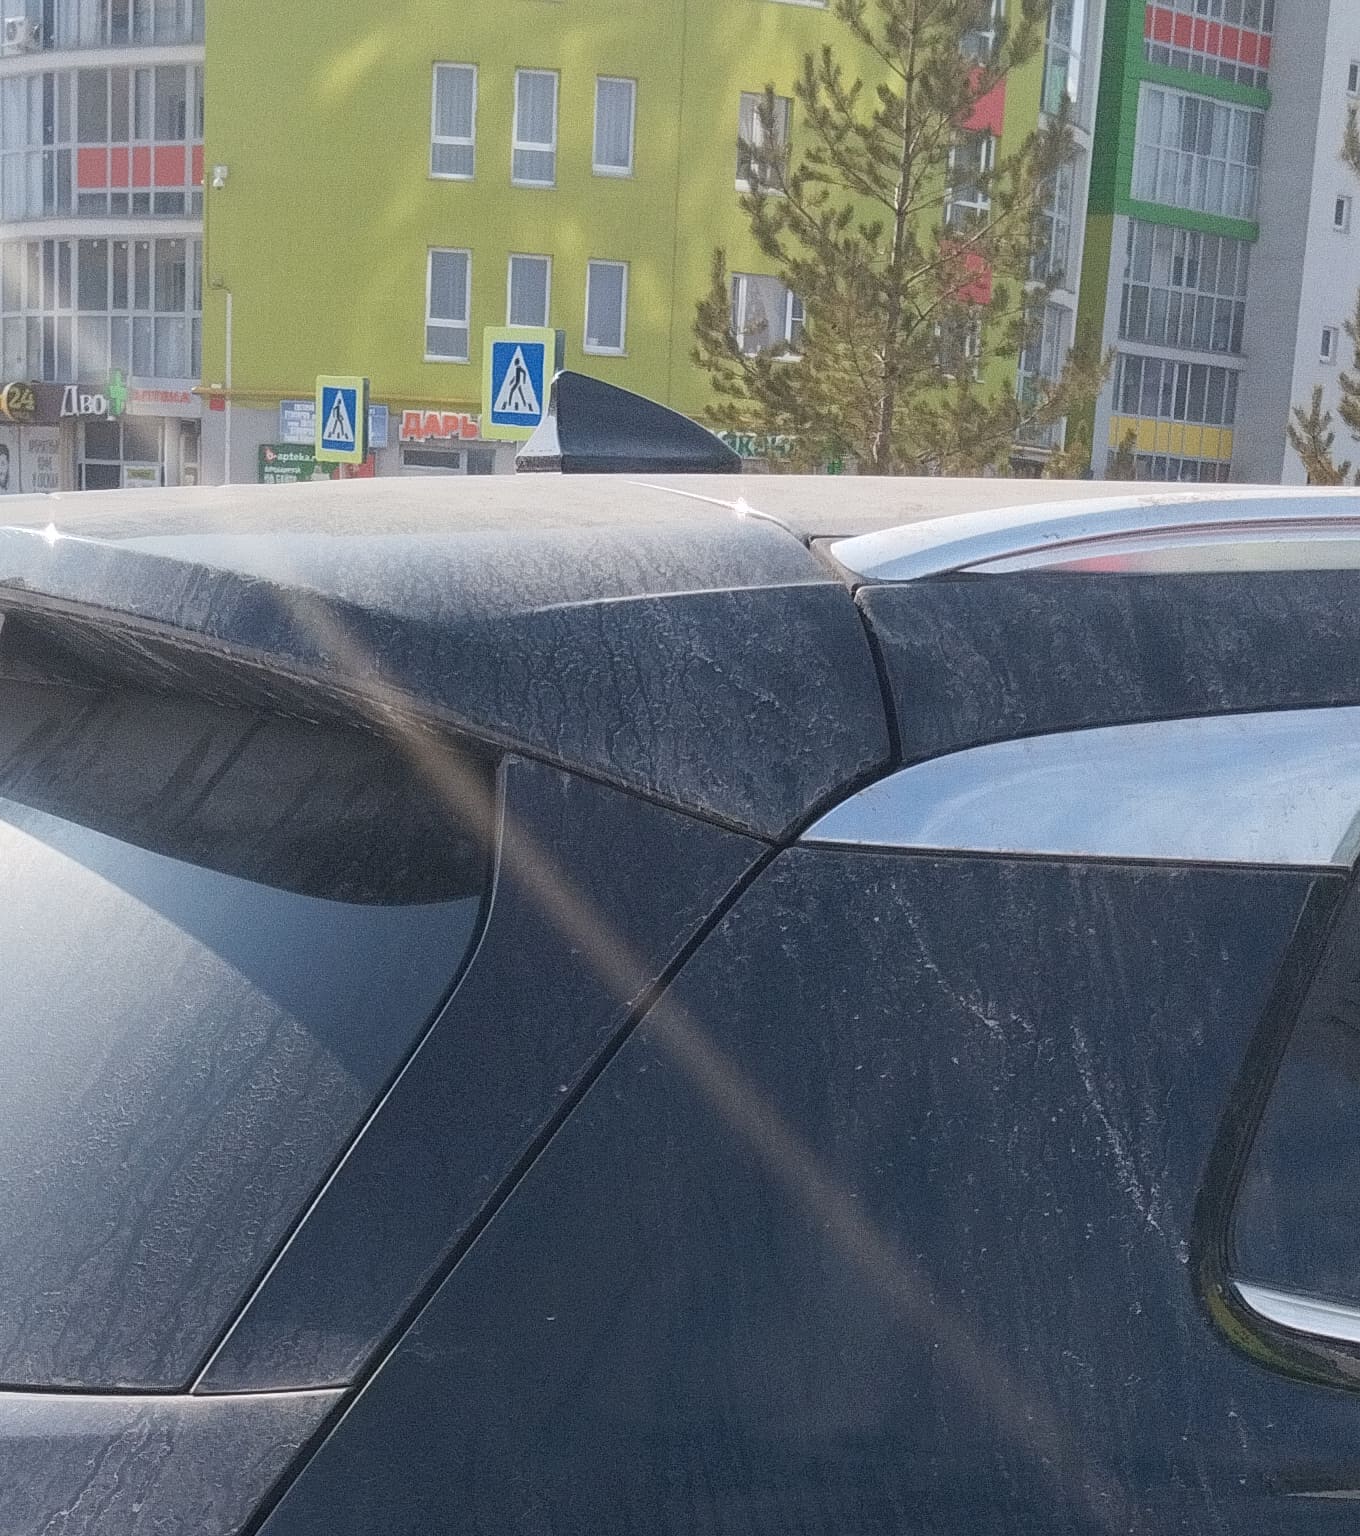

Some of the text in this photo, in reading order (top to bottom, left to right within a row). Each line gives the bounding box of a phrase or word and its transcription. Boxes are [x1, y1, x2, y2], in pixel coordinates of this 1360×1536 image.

[9, 387, 36, 411] 24
[60, 385, 113, 420] Дво
[399, 410, 482, 442] ДАРЬ
